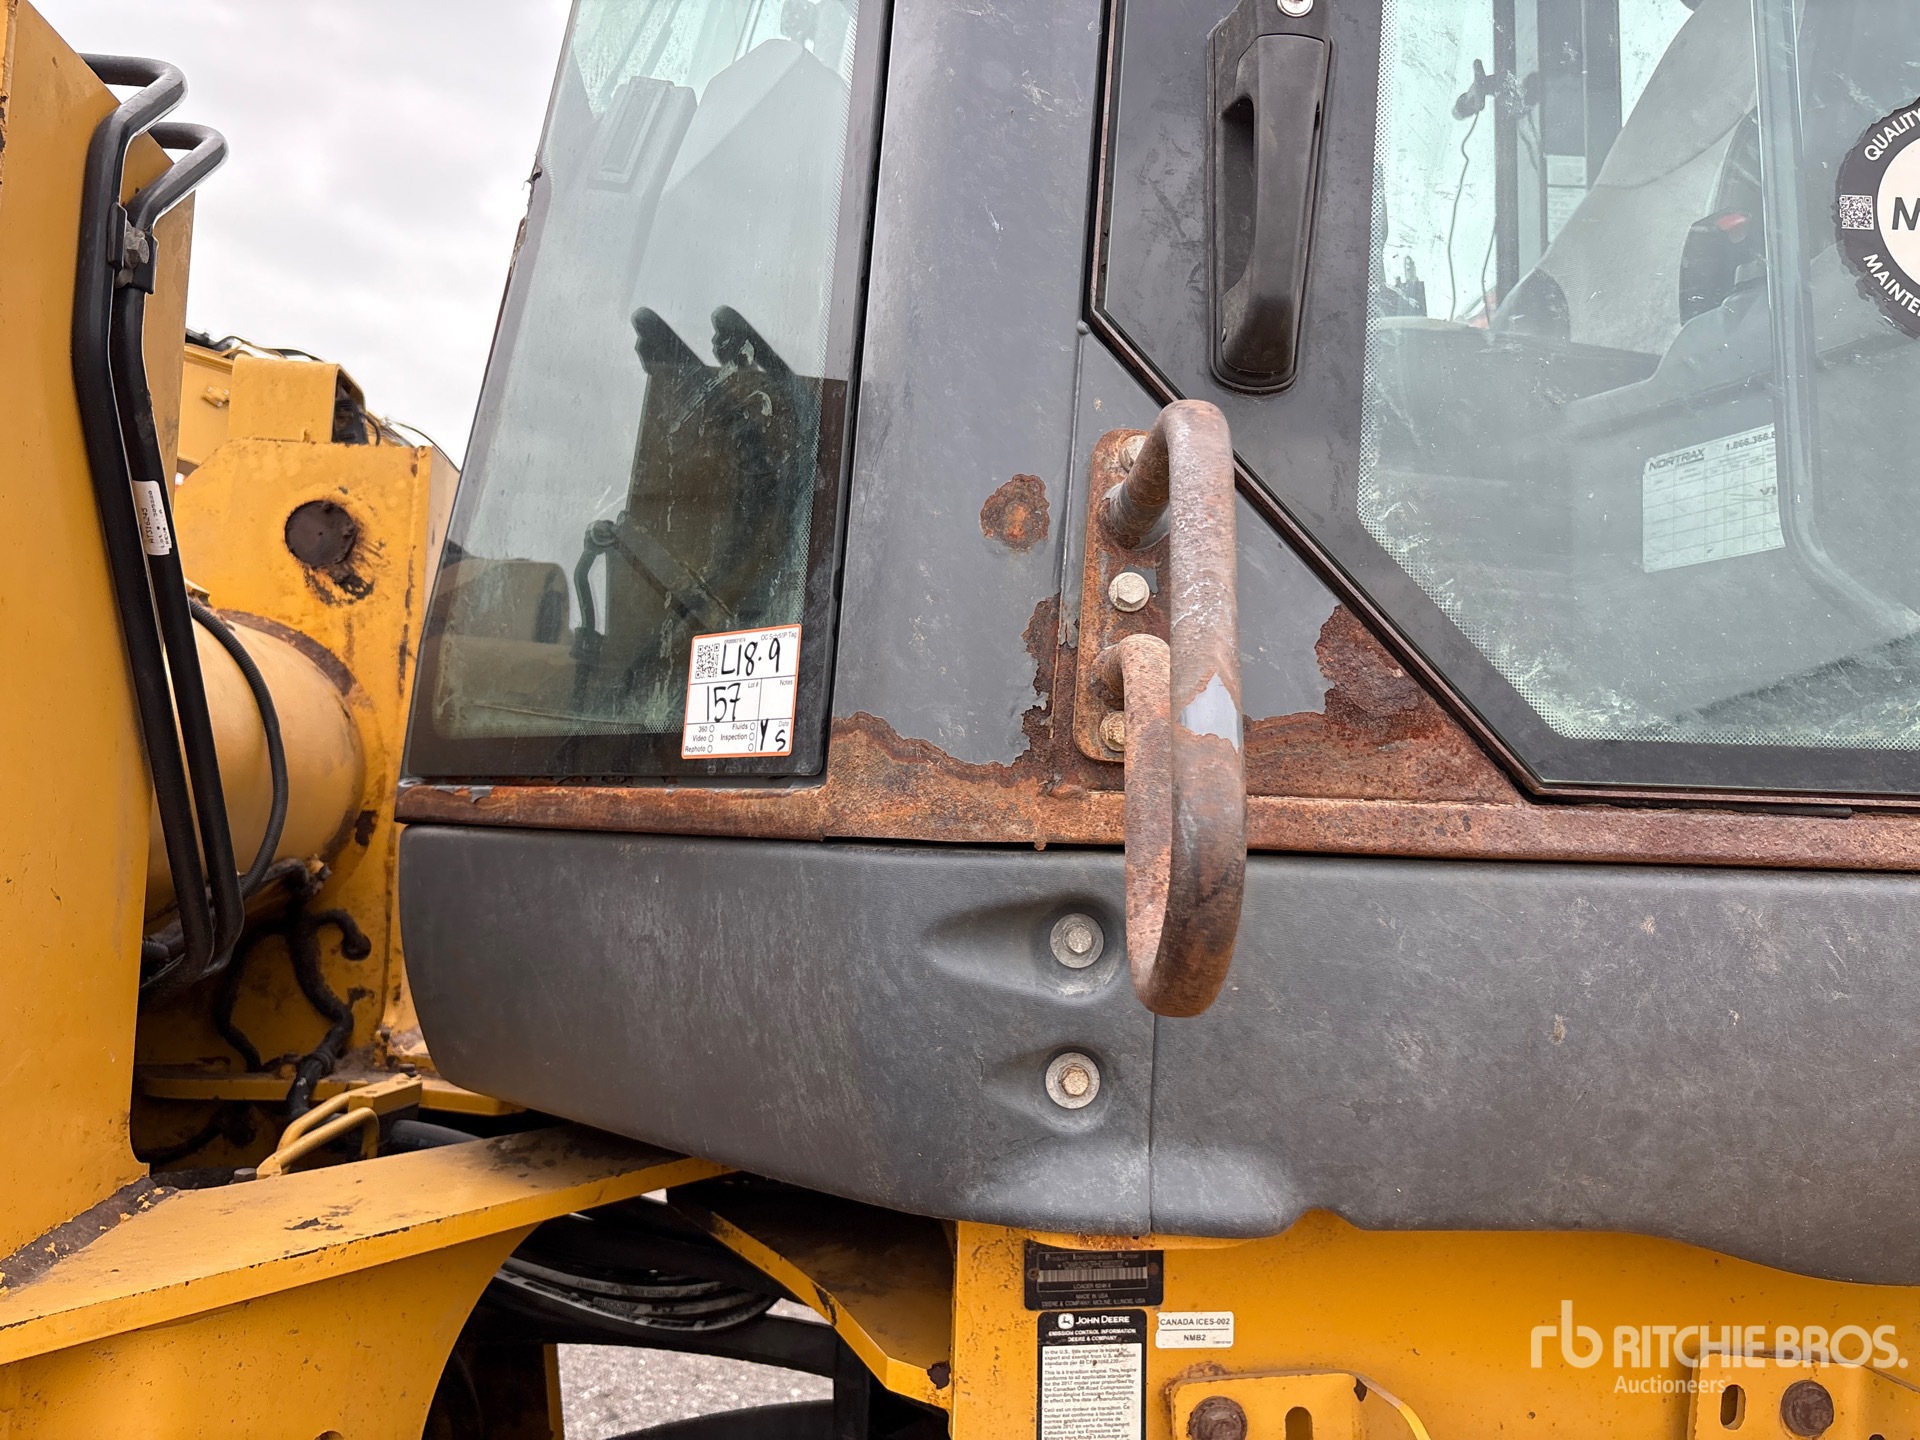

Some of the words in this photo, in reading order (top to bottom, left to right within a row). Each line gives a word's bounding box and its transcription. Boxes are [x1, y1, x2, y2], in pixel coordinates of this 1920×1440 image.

[1863, 254, 1920, 317] MAINTE
[1648, 447, 1706, 471] NORTRAX
[789, 631, 798, 639] Tag
[706, 682, 741, 723] 157
[720, 733, 747, 742] Inspection
[684, 745, 706, 753] Rephoto
[1075, 1316, 1100, 1325] JOHN
[1101, 1315, 1130, 1324] DEERE
[1160, 1318, 1194, 1326] CANADA
